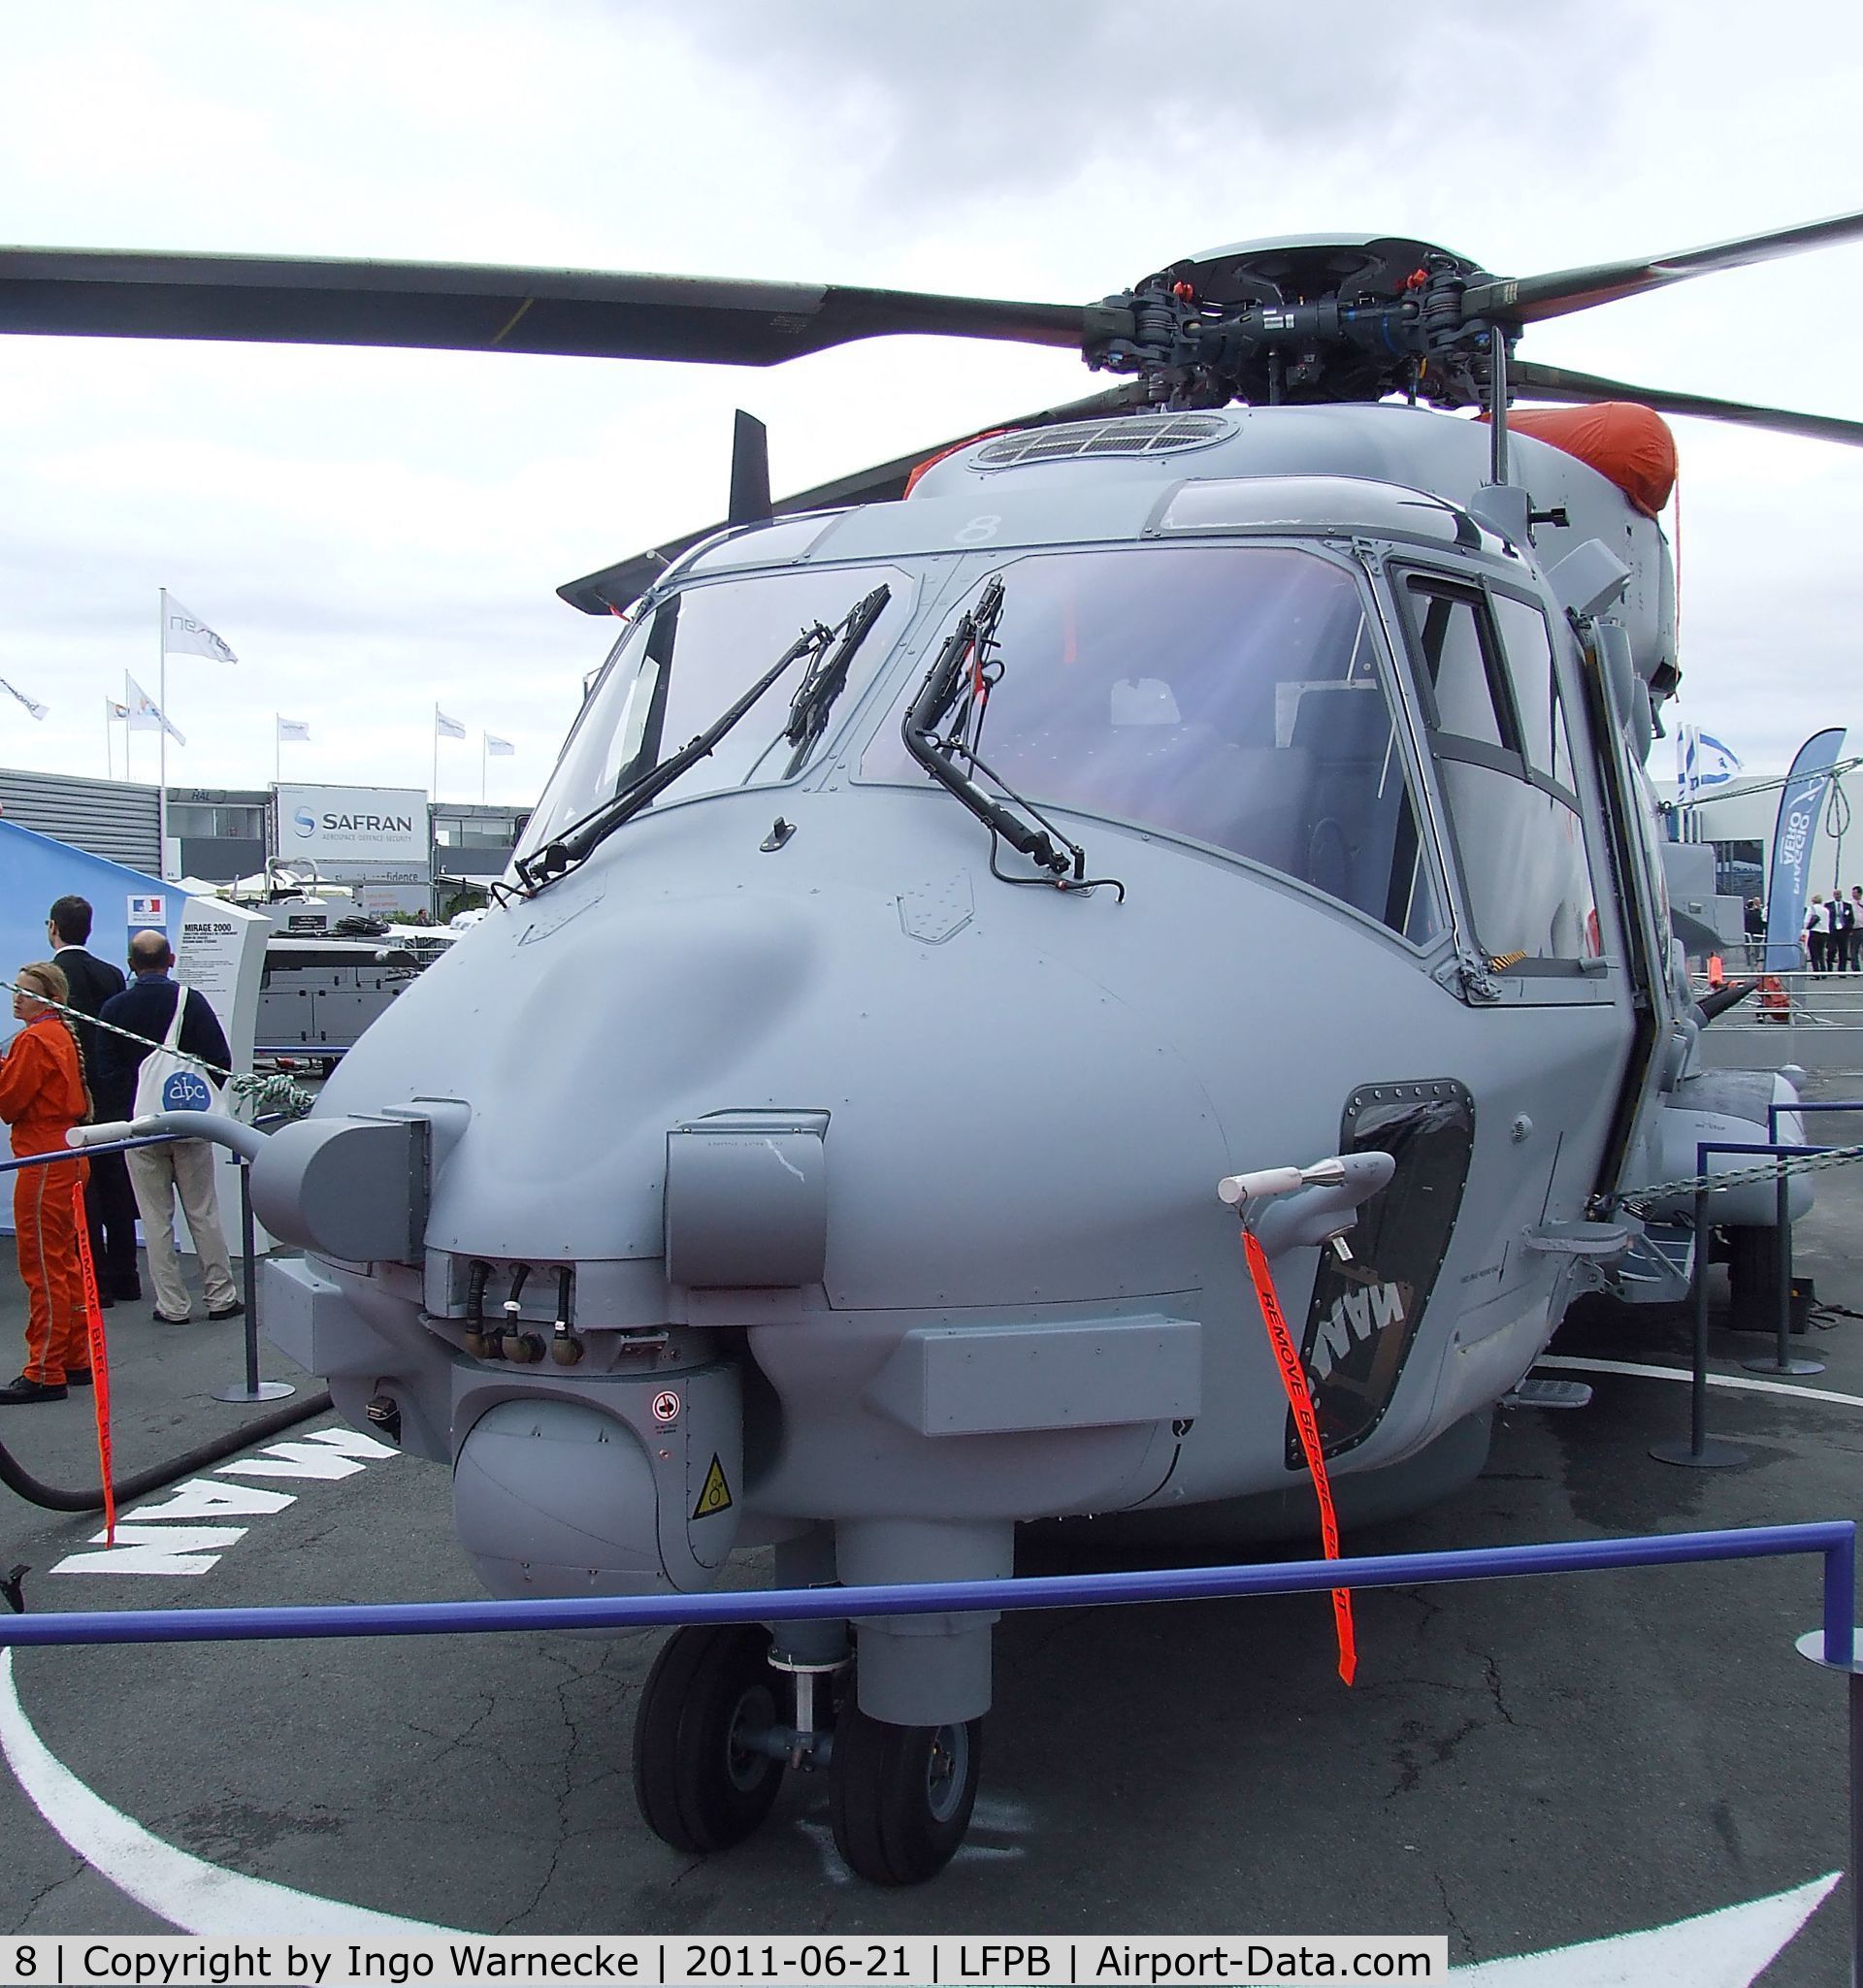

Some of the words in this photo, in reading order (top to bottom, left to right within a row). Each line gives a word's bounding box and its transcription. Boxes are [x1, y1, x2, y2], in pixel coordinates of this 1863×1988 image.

[955, 515, 1001, 543] 8
[322, 813, 412, 831] SAFRAN
[170, 1077, 205, 1100] abc
[80, 1228, 97, 1317] REMOVE
[1261, 1291, 1304, 1397] REMOVE
[1299, 1409, 1330, 1513] BEFORE
